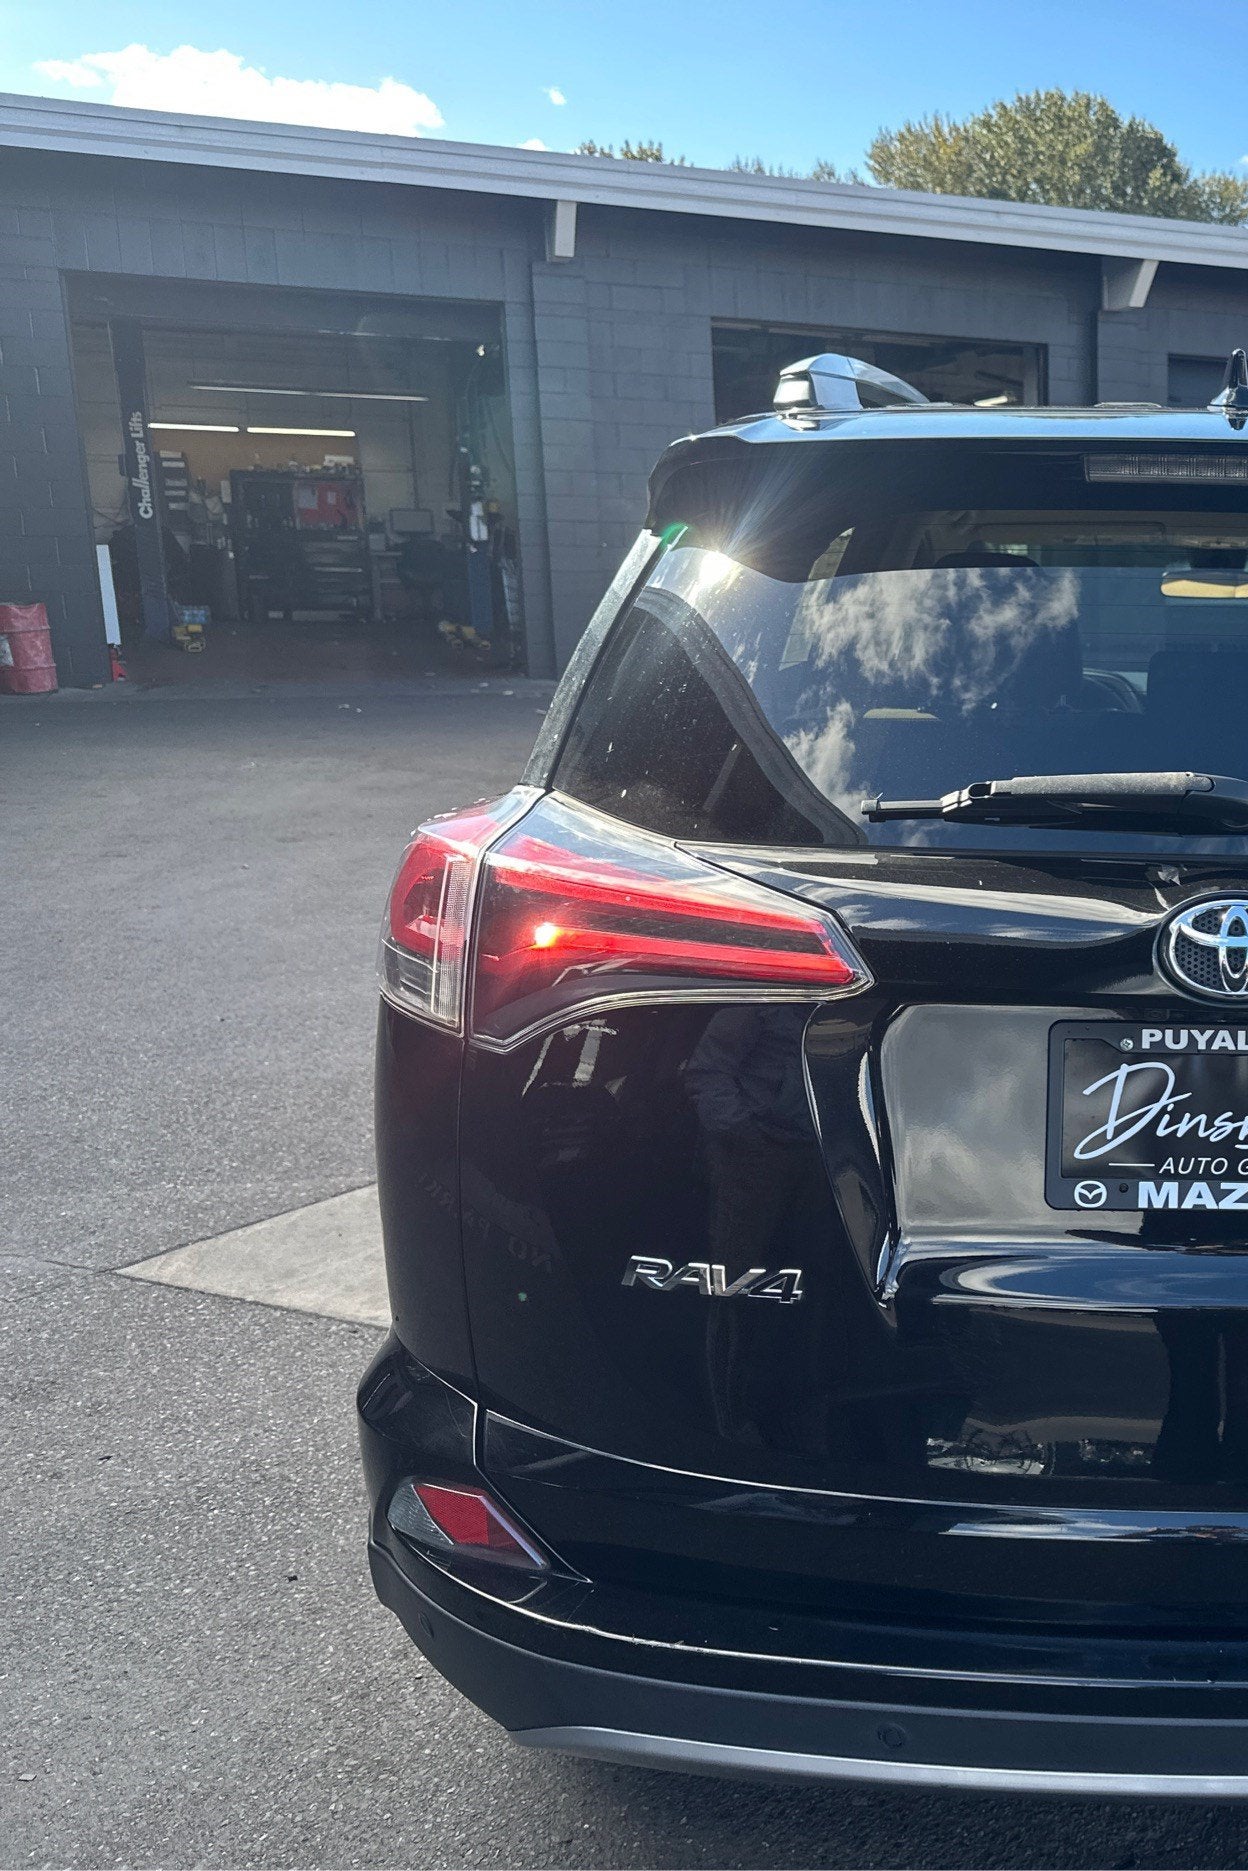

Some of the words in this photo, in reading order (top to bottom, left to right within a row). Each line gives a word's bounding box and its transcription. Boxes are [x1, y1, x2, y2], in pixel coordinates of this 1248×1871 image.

[129, 411, 144, 438] Lifts
[131, 440, 153, 519] Challenger
[1159, 1156, 1229, 1176] AUTO
[621, 1255, 803, 1304] RAV4
